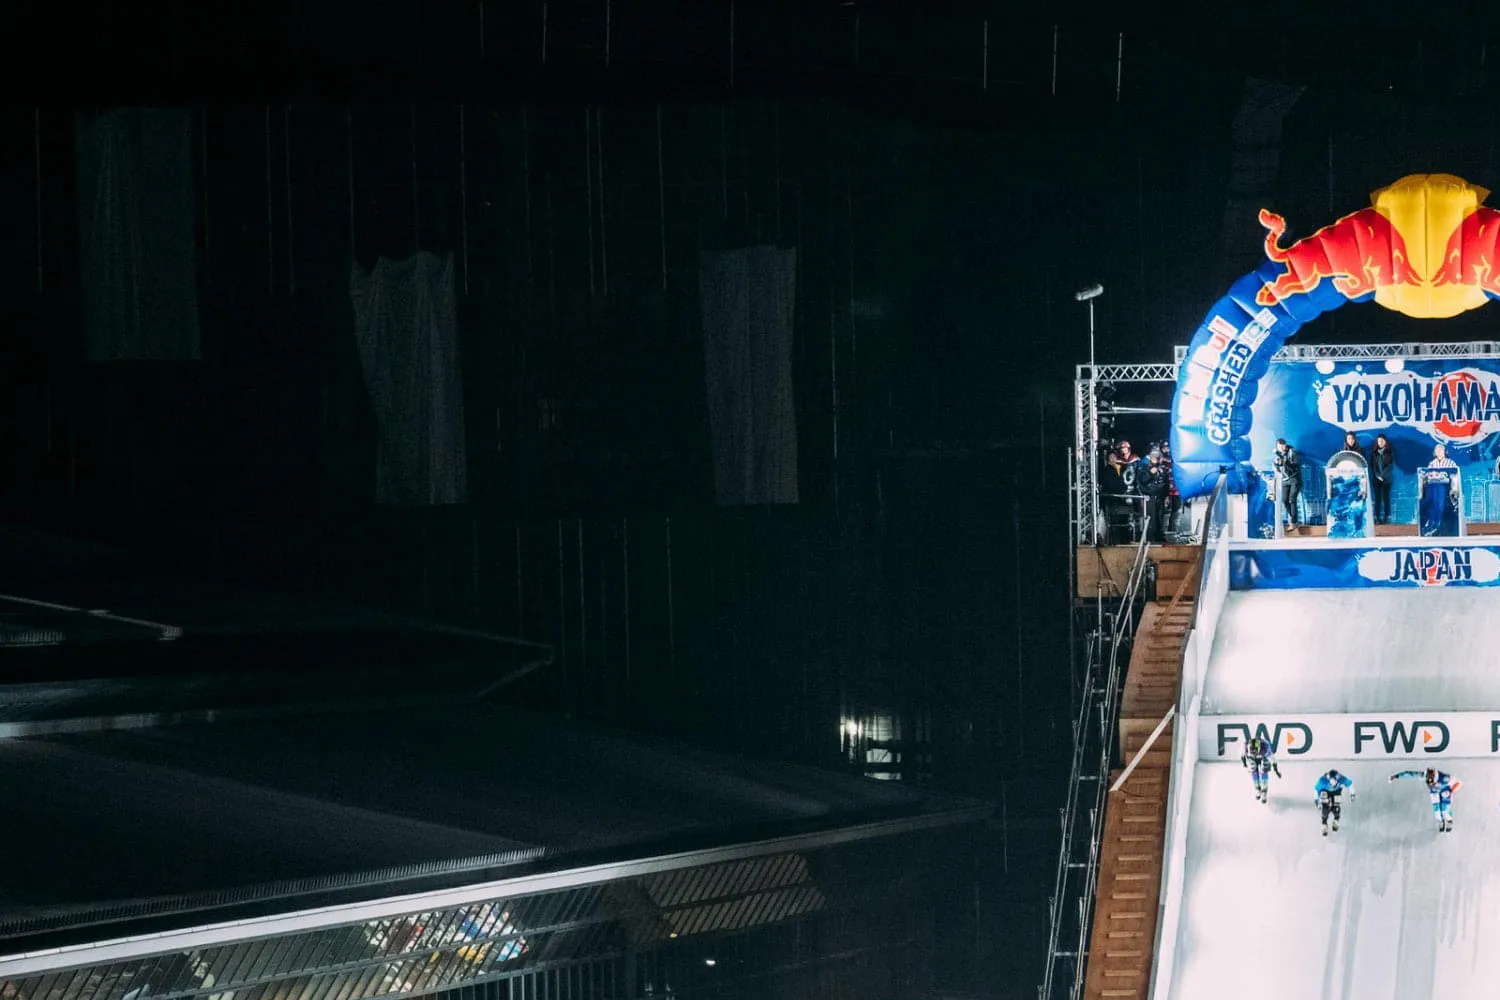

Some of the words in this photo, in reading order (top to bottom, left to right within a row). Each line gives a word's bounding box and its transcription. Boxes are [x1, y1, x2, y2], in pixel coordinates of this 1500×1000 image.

[1209, 341, 1252, 443] CRASHED
[1390, 551, 1472, 581] JAPAN
[1354, 721, 1450, 754] FWD
